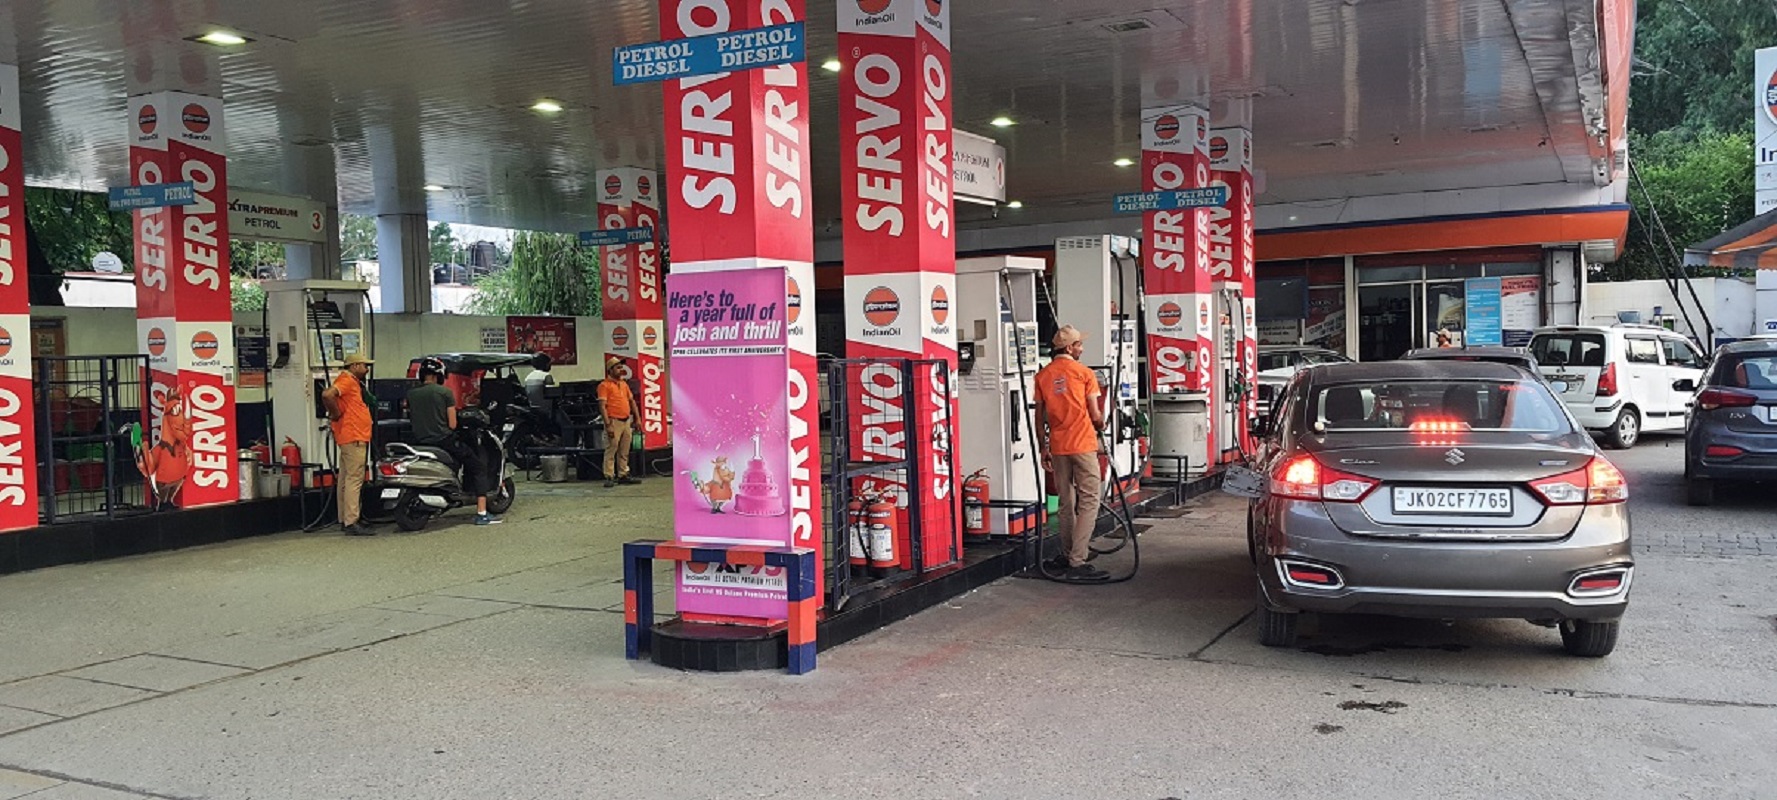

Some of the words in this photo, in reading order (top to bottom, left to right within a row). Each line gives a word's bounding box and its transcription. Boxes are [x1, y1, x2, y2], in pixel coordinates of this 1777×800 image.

[856, 13, 895, 26] IndianOil
[717, 28, 797, 52] PETROL
[619, 43, 693, 64] PETROL
[721, 45, 793, 67] DIESEL
[622, 59, 690, 80] DIESEL
[677, 0, 736, 214] SERO
[854, 53, 904, 237] SERVO
[923, 54, 949, 238] SERVO
[164, 186, 192, 201] PETROL
[1117, 193, 1162, 203] PETROL
[1175, 189, 1222, 199] PETROL
[1177, 197, 1219, 208] DIESEL
[1119, 201, 1159, 211] DIESEL
[181, 159, 220, 291] SERVO
[244, 218, 281, 229] PETROL
[312, 212, 320, 230] 3
[1152, 162, 1185, 273] SERO
[1197, 162, 1209, 273] SERO
[1243, 180, 1253, 278] SERVO
[669, 291, 714, 309] Here's
[719, 289, 734, 307] to
[680, 310, 688, 323] a
[694, 309, 727, 326] year
[730, 304, 754, 321] full
[760, 303, 776, 320] of
[673, 323, 705, 345] josh
[710, 322, 740, 341] and
[744, 320, 781, 340] thrill
[863, 327, 901, 337] IndianOil
[643, 362, 663, 434] SERVO
[190, 384, 229, 489] SERVO
[930, 361, 953, 501] SERVO
[1407, 491, 1509, 510] JK02CF7765
[682, 586, 701, 594] India's
[769, 592, 787, 600] Petrol
[765, 578, 783, 587] PETROL
